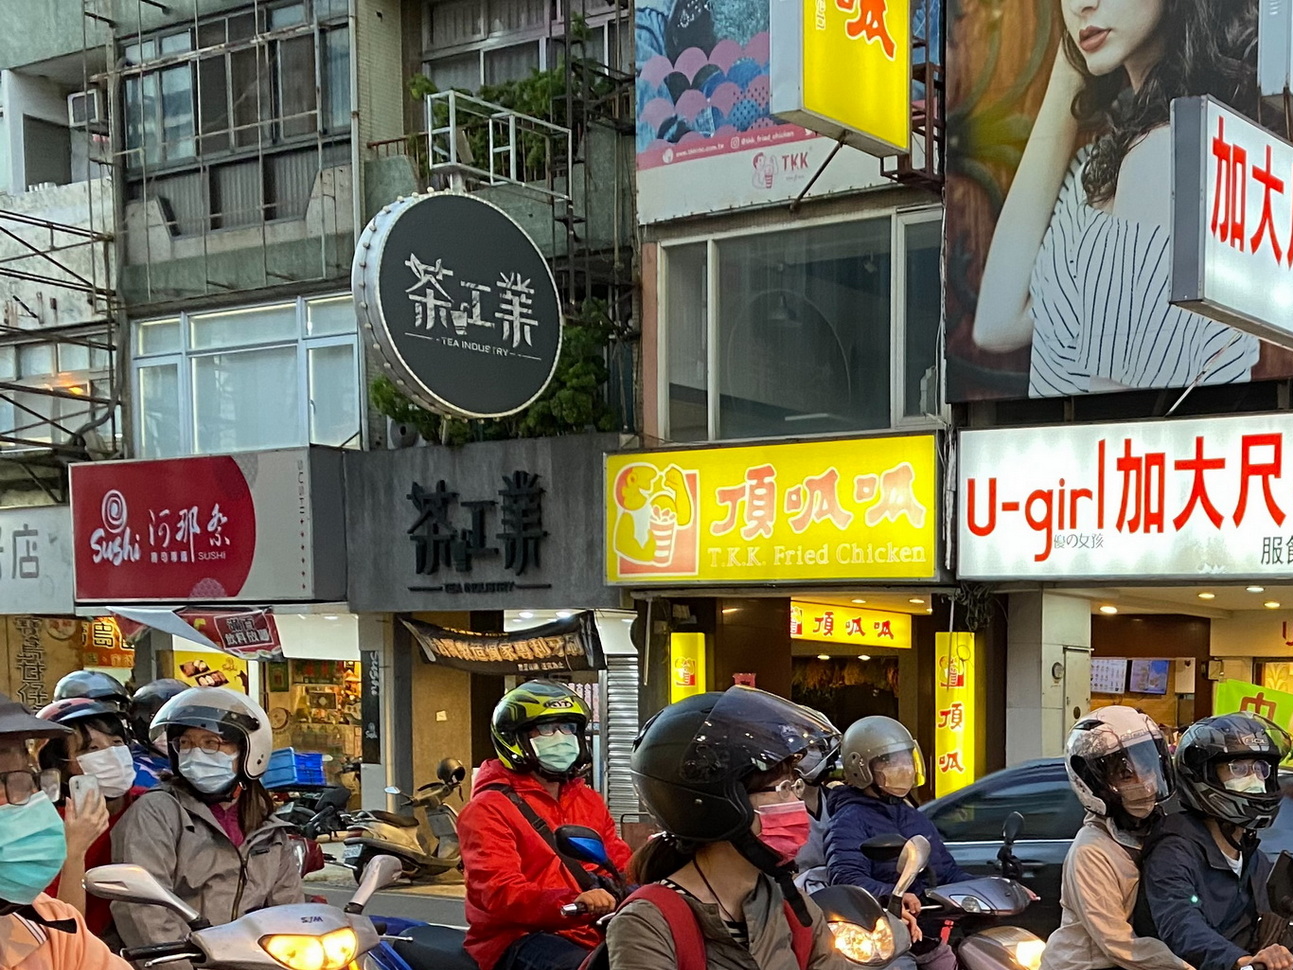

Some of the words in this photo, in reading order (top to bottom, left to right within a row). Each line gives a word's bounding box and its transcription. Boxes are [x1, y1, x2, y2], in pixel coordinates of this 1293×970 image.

[781, 151, 809, 172] TKK
[441, 336, 460, 348] TEA
[461, 340, 510, 357] INDUSTRY
[709, 461, 927, 542] 頂呱呱
[967, 438, 1106, 562] U-girl
[0, 523, 39, 579] 店
[198, 551, 226, 561] SUSHI
[773, 545, 830, 566] Fried
[835, 541, 927, 564] Chicken
[812, 611, 896, 640] 頂呱呱
